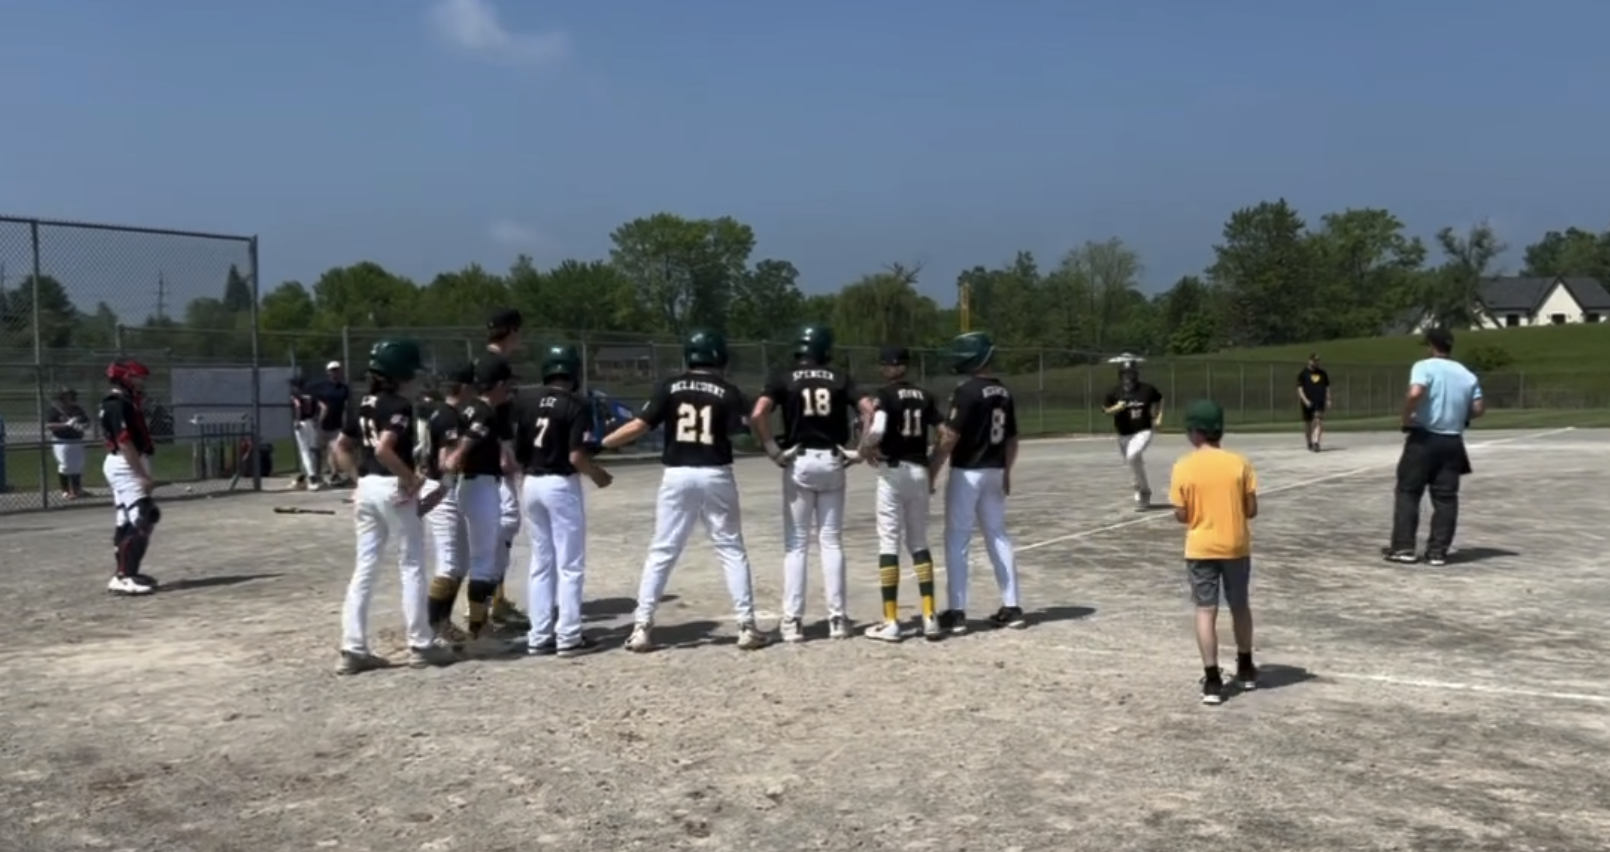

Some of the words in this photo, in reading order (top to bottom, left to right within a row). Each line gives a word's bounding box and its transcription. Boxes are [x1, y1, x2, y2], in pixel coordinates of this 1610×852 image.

[802, 387, 832, 416] 18
[533, 417, 549, 448] 7
[676, 402, 714, 445] 21
[901, 408, 922, 436] 11
[990, 408, 1005, 444] 8
